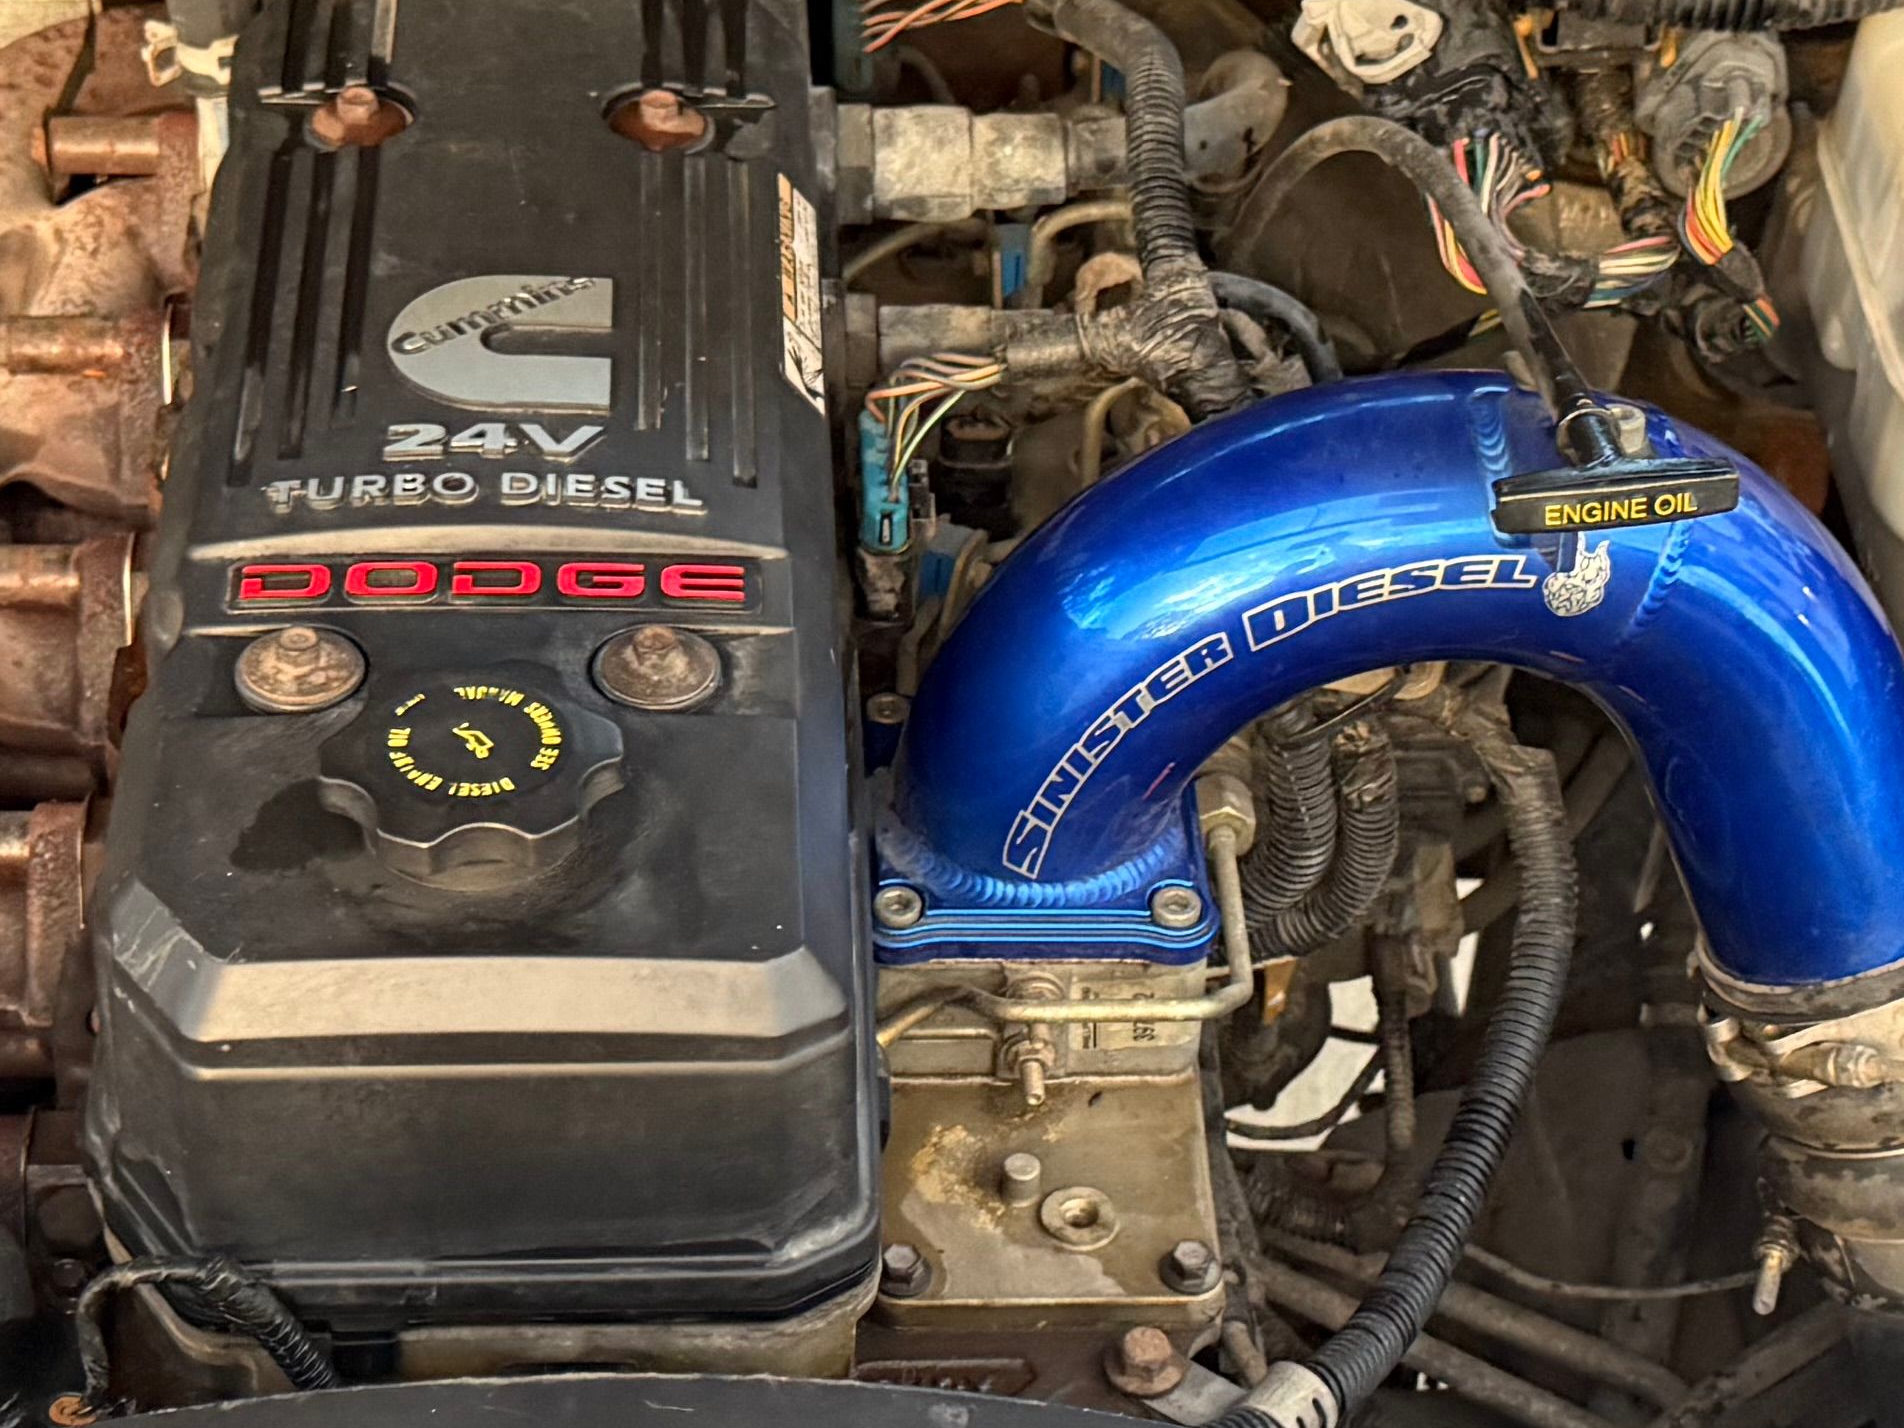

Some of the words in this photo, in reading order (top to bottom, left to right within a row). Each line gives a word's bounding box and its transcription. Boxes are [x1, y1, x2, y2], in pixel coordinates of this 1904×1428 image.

[394, 274, 598, 356] Cummins
[382, 422, 608, 461] 24V
[270, 471, 478, 512] TURBO
[501, 472, 707, 514] DIESEL
[1544, 497, 1649, 527] ENGINE
[1654, 491, 1698, 519] OIL
[238, 560, 746, 603] DODGE
[1002, 631, 1233, 881] SINISTER
[1245, 553, 1540, 652] DIESEL
[387, 727, 411, 748] OIL
[530, 747, 560, 771] SEE
[448, 777, 516, 797] DIESEL
